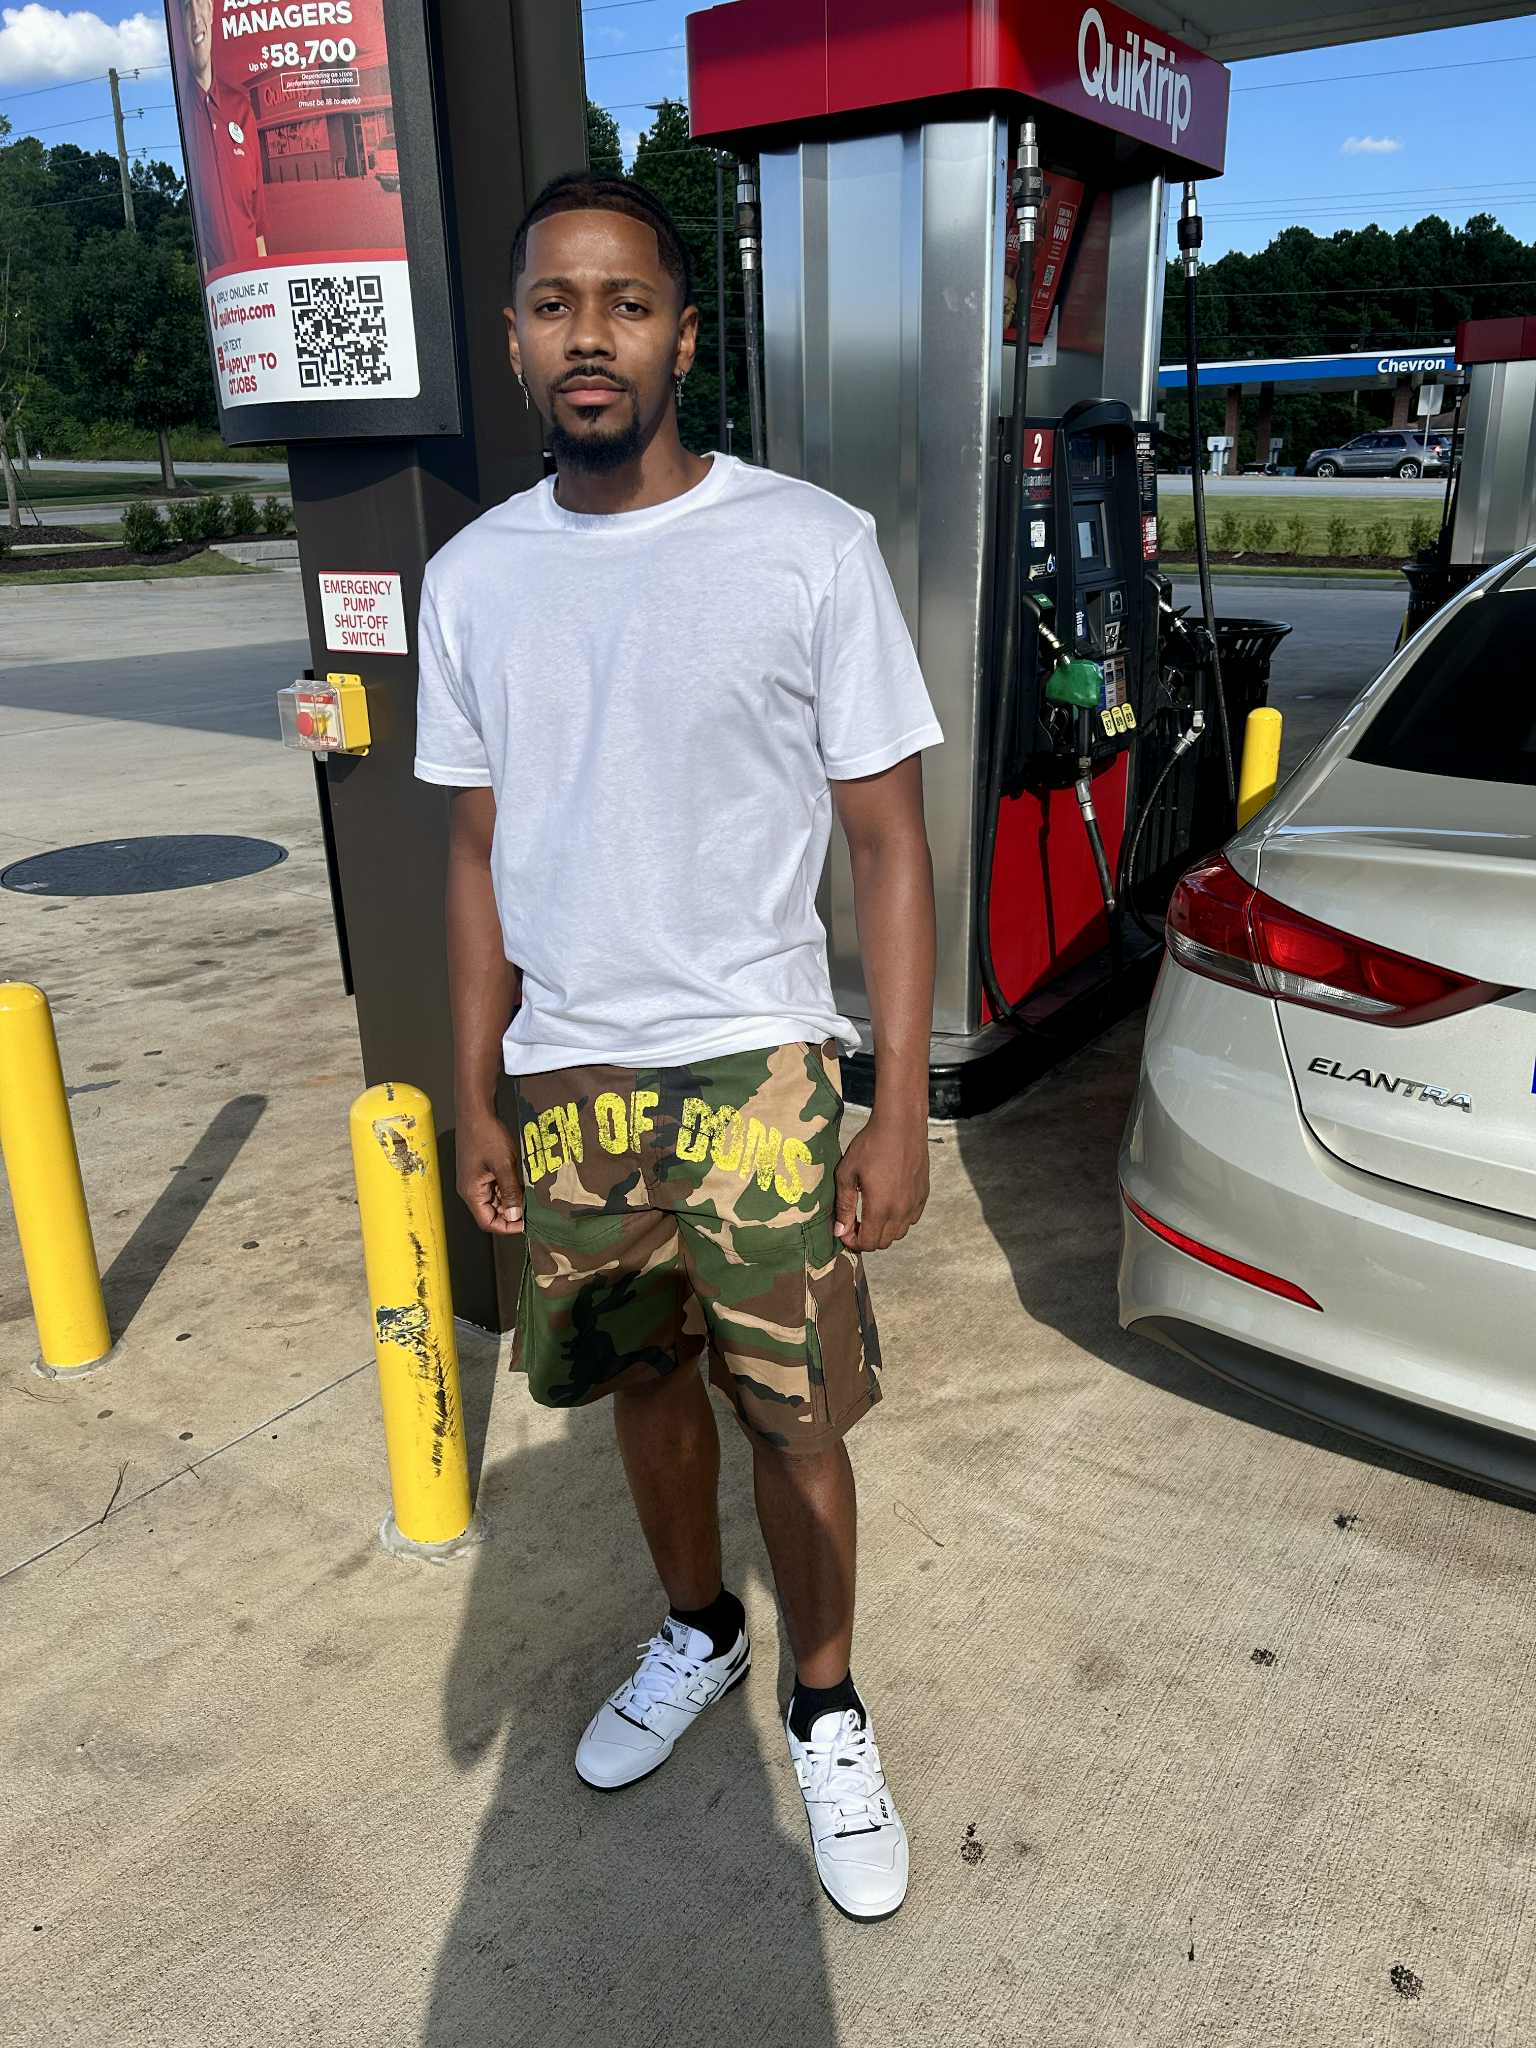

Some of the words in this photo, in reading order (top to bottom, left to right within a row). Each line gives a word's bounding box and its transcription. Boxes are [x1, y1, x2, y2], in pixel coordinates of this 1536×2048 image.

[222, 0, 353, 40] MANAGERS
[261, 38, 356, 69] $58,700
[248, 62, 259, 73] Up
[259, 60, 268, 70] to
[301, 73, 331, 81] Depending
[1077, 7, 1192, 144] QuikTrip
[286, 79, 319, 89] performance
[298, 99, 315, 108] (must
[340, 97, 361, 105] apply)
[216, 289, 229, 305] APPLY
[229, 285, 256, 300] ONLINE
[257, 282, 269, 295] AT
[219, 302, 276, 331] quiktrip.com
[229, 338, 242, 351] TEXT
[258, 352, 277, 370] TO
[1377, 358, 1446, 374] Chevron
[1033, 433, 1043, 464] 2
[323, 579, 393, 596] EMERGENCY
[343, 597, 376, 612] PUMP
[334, 614, 389, 630] SHUT-OFF
[342, 631, 385, 647] SWITCH
[1307, 1056, 1473, 1114] ELANTRA
[523, 1102, 584, 1184] DEN
[594, 1090, 660, 1155] OF
[675, 1097, 813, 1205] DONS
